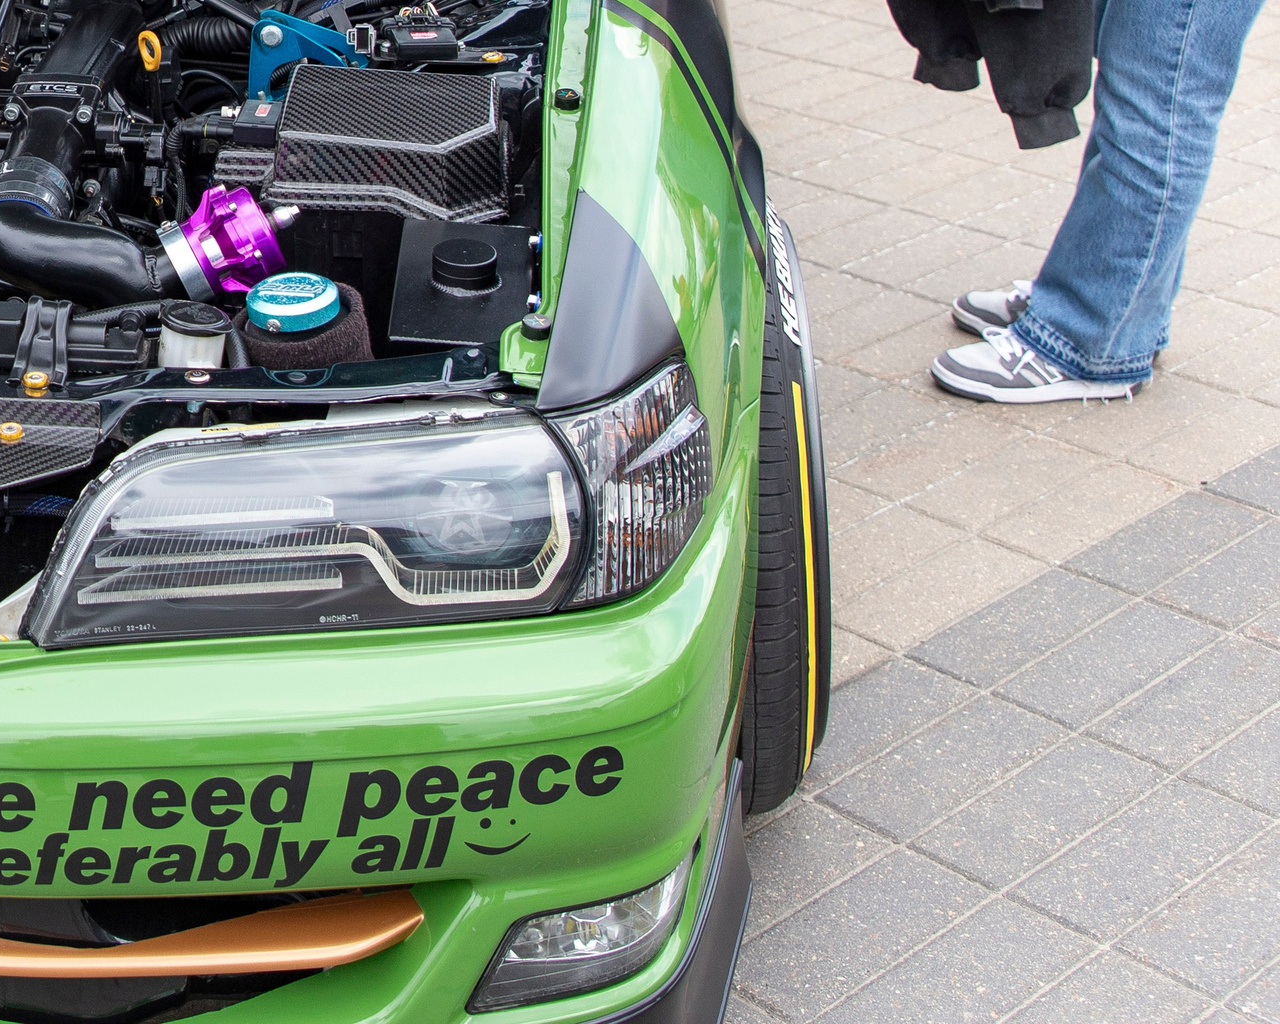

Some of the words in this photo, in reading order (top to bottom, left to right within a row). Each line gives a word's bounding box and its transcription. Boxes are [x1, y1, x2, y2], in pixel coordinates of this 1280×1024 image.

[93, 625, 122, 634] STANLEY
[126, 623, 151, 632] 22-247
[326, 614, 359, 623] HCHR-11
[67, 761, 314, 833] need
[336, 745, 625, 838] peace
[352, 816, 456, 875] all
